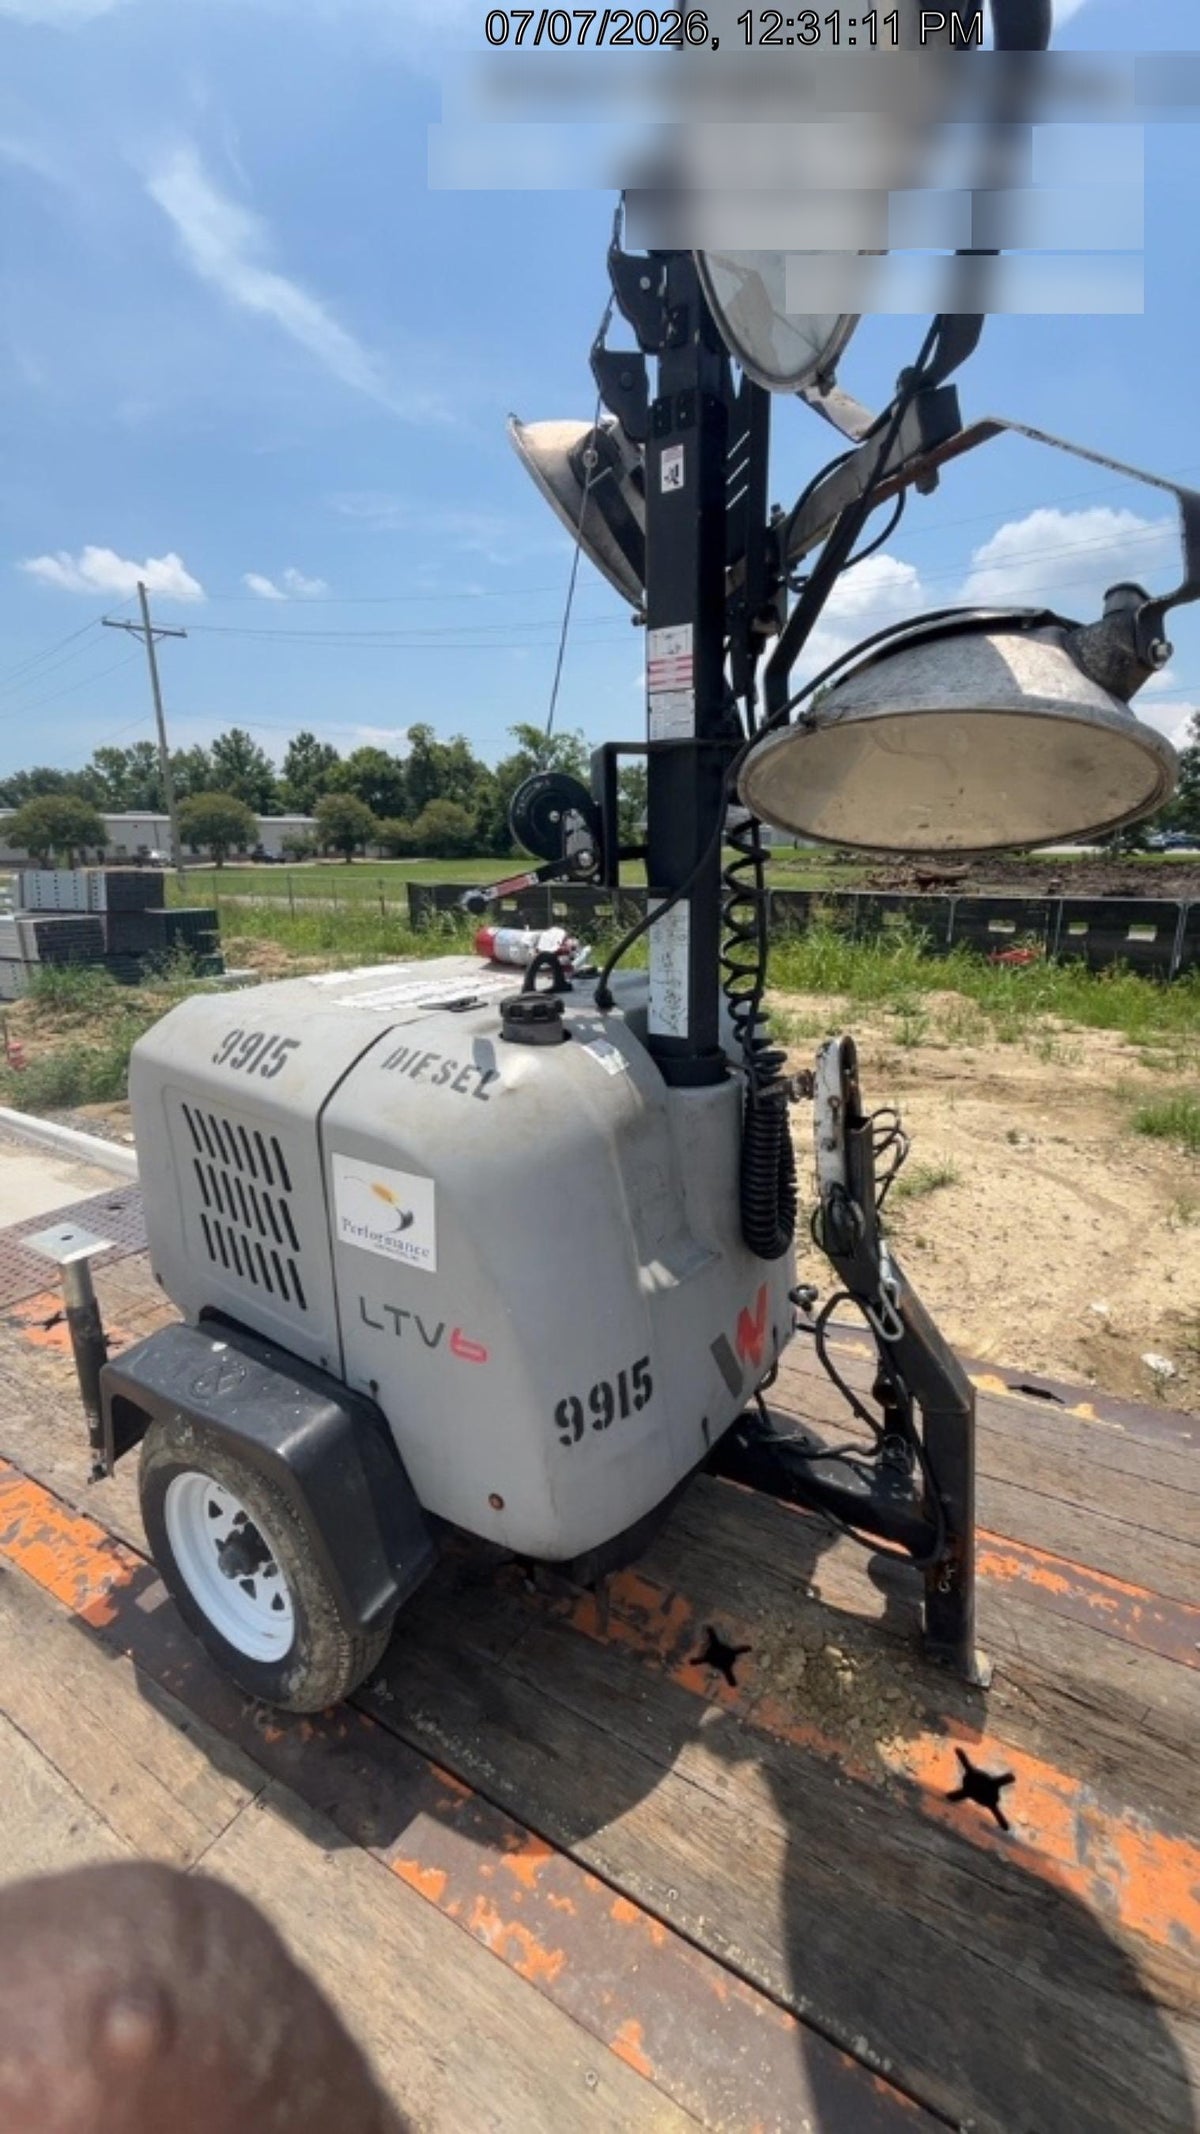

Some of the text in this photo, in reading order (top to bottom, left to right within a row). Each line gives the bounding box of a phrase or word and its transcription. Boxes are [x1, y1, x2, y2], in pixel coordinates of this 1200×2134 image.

[211, 1029, 302, 1080] 9915
[380, 1045, 496, 1102] DIESEL
[341, 1216, 431, 1257] Performance
[554, 1355, 654, 1447] 9915
